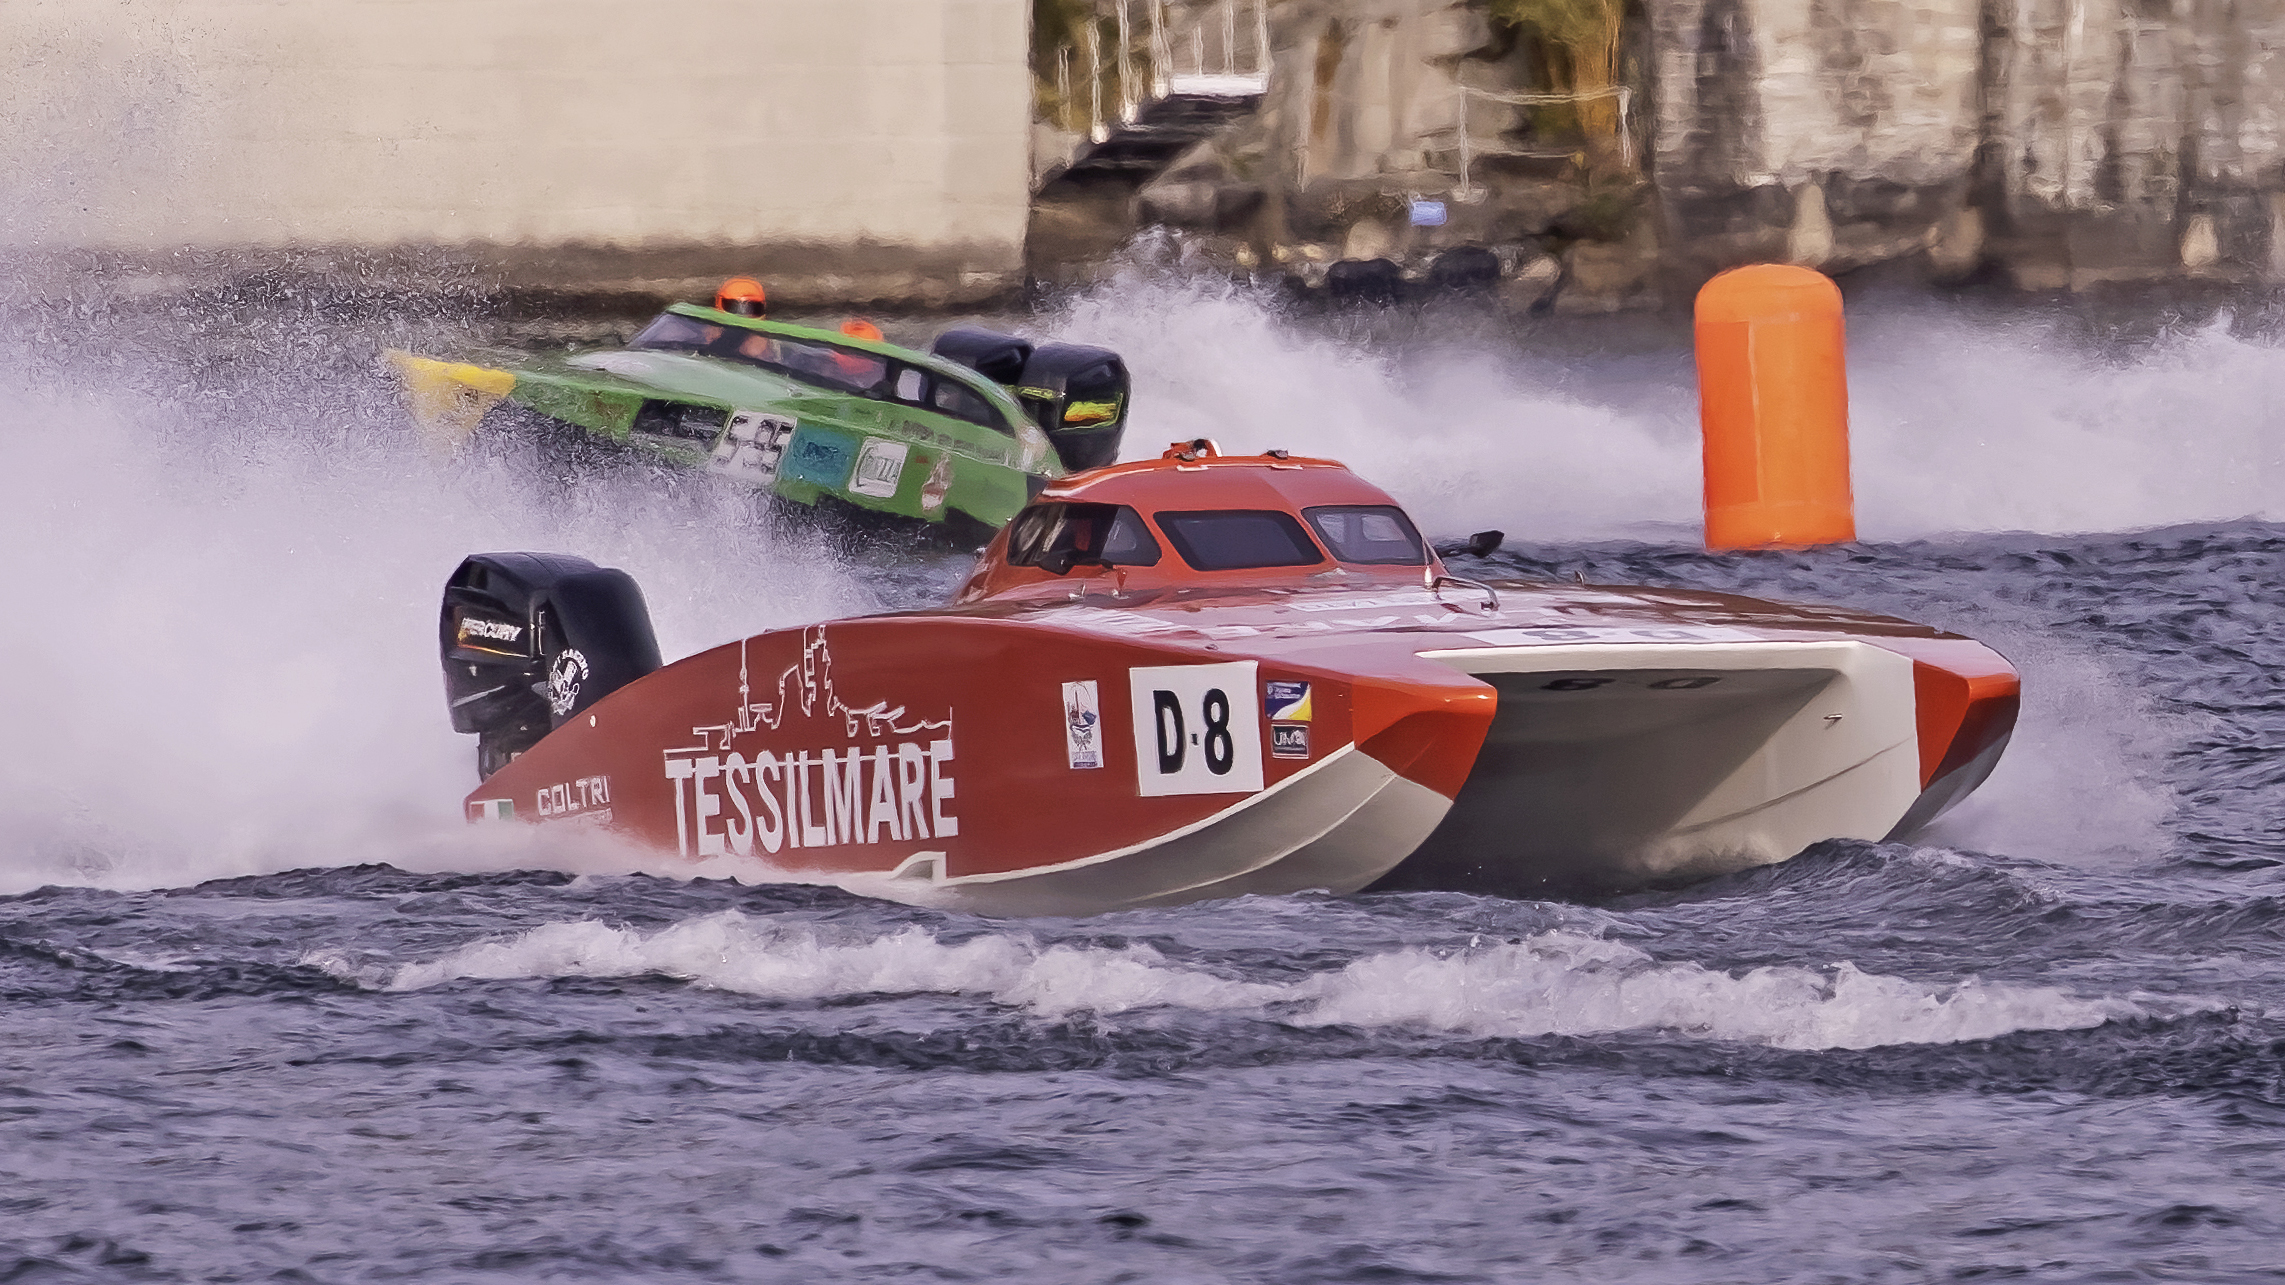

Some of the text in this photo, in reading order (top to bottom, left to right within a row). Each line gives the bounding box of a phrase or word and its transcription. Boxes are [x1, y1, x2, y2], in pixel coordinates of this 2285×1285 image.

[458, 618, 523, 641] MERCURY
[1153, 688, 1234, 775] D-8
[538, 775, 611, 816] COLTRI
[665, 740, 958, 857] TESSILMARE
